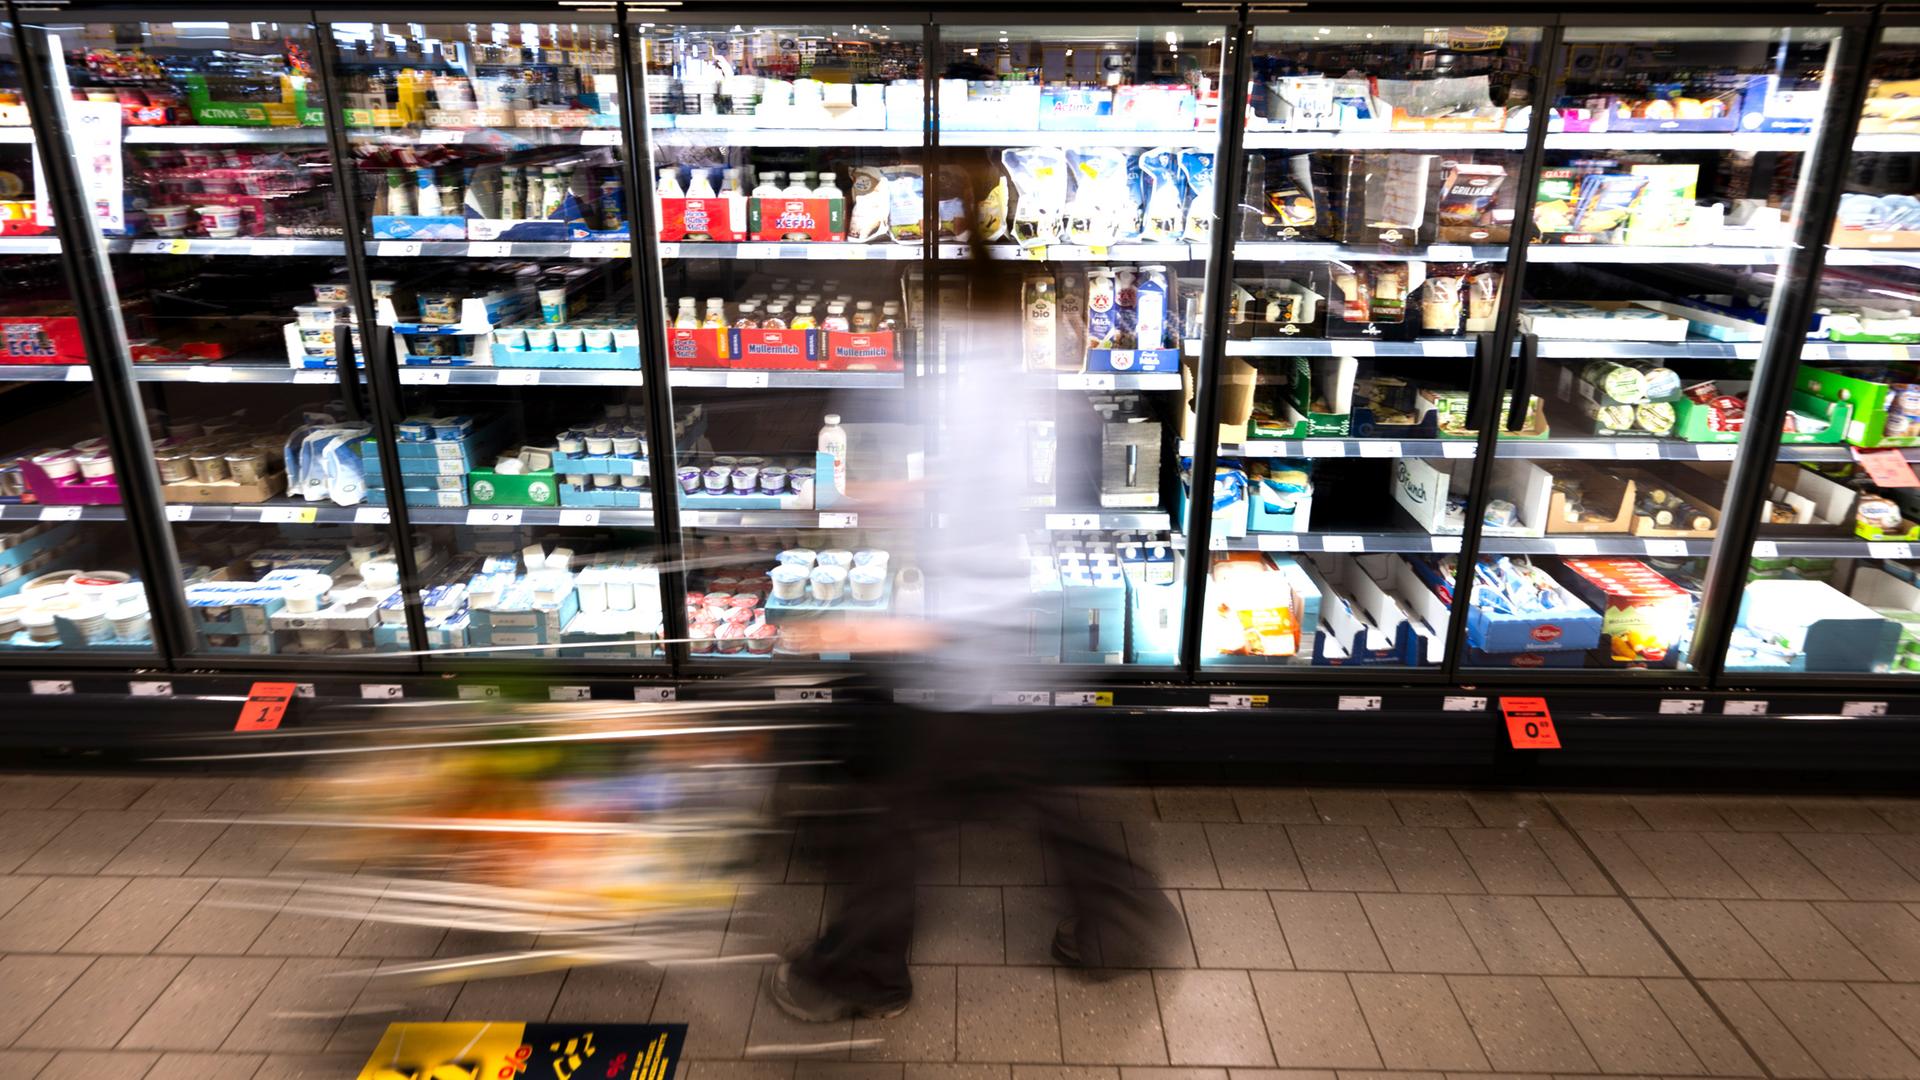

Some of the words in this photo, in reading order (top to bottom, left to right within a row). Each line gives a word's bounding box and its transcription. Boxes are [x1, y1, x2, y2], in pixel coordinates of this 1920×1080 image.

[200, 108, 239, 119] ACTIVIA
[1450, 184, 1497, 197] GRILLK
[775, 219, 816, 230] KEFIR
[293, 226, 321, 236] HIGH
[1031, 309, 1051, 319] bio
[1060, 304, 1080, 313] bio
[748, 343, 800, 354] Müllermilch
[836, 346, 888, 357] Müllermilch
[1398, 461, 1428, 502] Brunch
[256, 706, 270, 723] 1
[1525, 721, 1539, 738] 0
